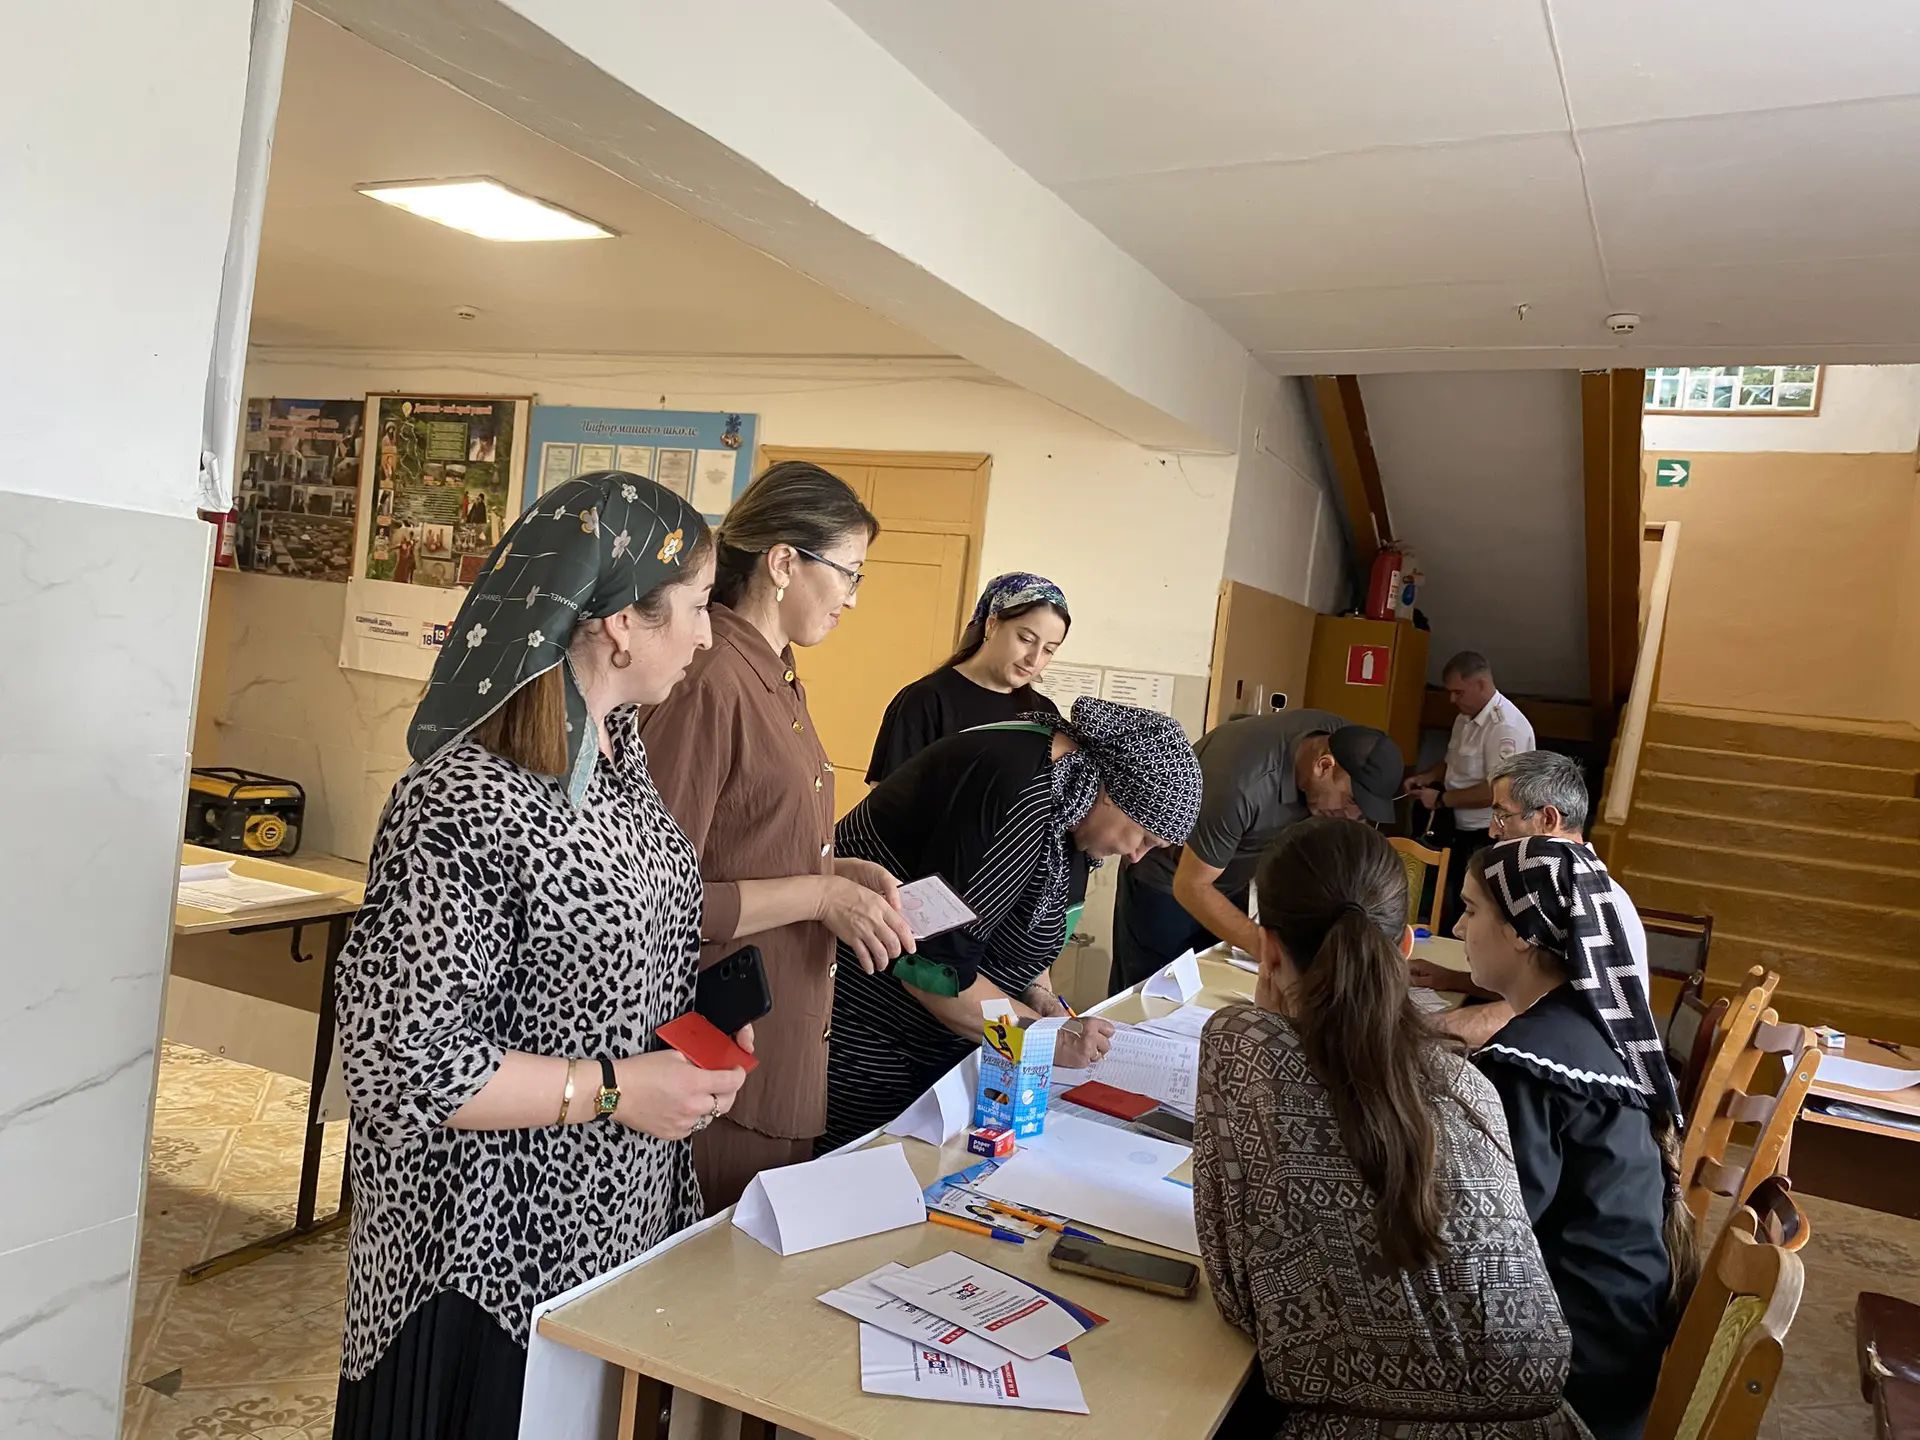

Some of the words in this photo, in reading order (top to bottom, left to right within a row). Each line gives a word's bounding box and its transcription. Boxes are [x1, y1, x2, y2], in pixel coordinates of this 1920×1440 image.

[582, 419, 652, 437] Информация
[663, 426, 697, 437] школе
[479, 593, 502, 602] CHANEL
[550, 592, 579, 610] CHANEL
[422, 634, 432, 645] 18
[435, 629, 446, 642] 19
[973, 1139, 991, 1149] paper
